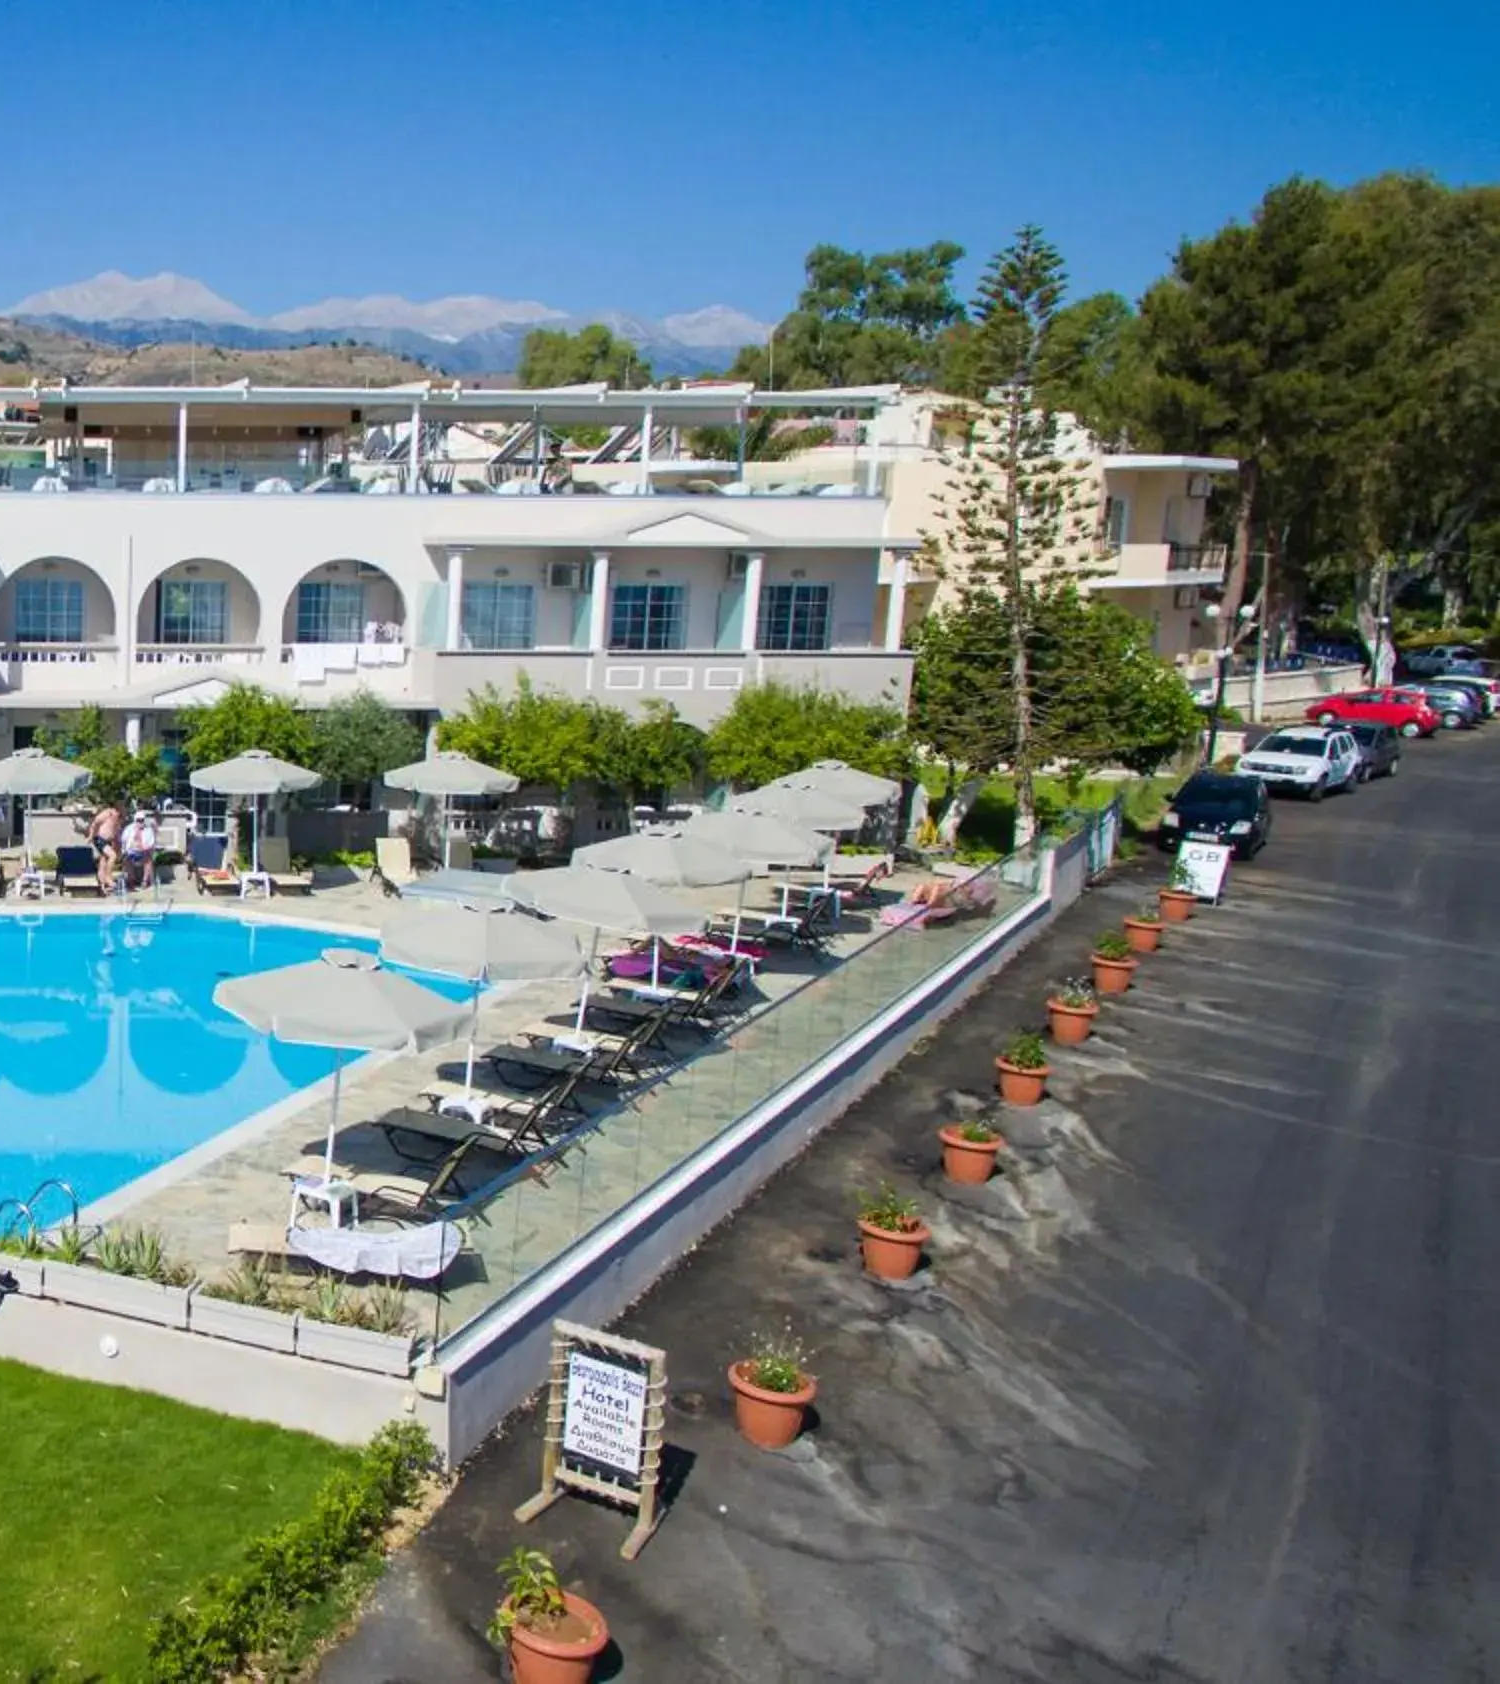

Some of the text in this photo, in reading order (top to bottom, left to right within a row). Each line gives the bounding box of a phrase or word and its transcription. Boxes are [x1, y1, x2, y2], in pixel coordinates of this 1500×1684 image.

[581, 1385, 629, 1412] Hotel
[573, 1399, 637, 1429] Available
[582, 1412, 623, 1435] Rooms
